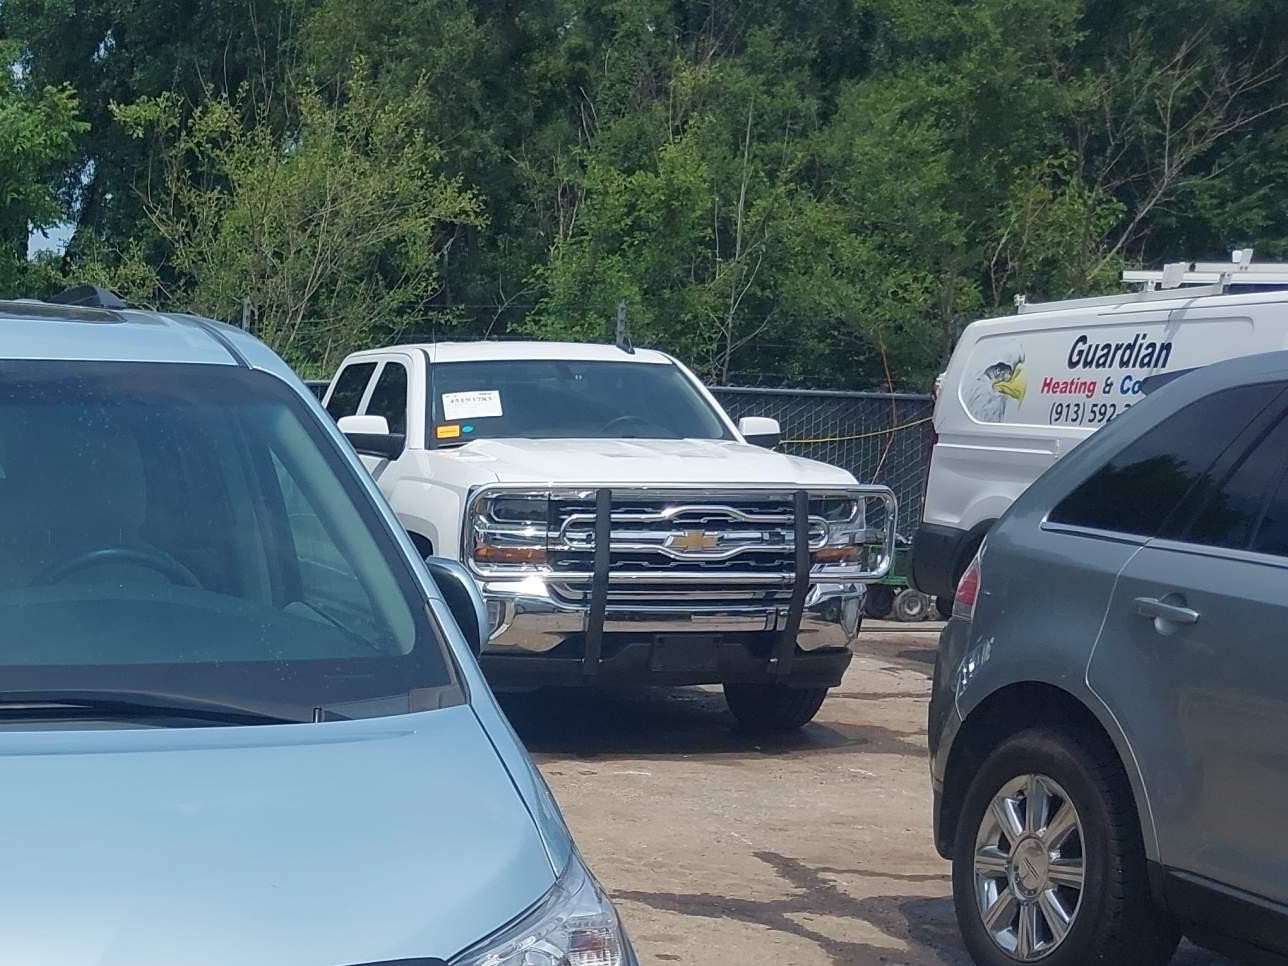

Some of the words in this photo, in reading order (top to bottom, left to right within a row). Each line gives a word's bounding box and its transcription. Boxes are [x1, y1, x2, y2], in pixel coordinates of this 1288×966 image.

[1067, 333, 1172, 369] Guardian
[1041, 377, 1096, 398] Heating
[1102, 376, 1113, 394] &
[1049, 402, 1085, 425] (913)
